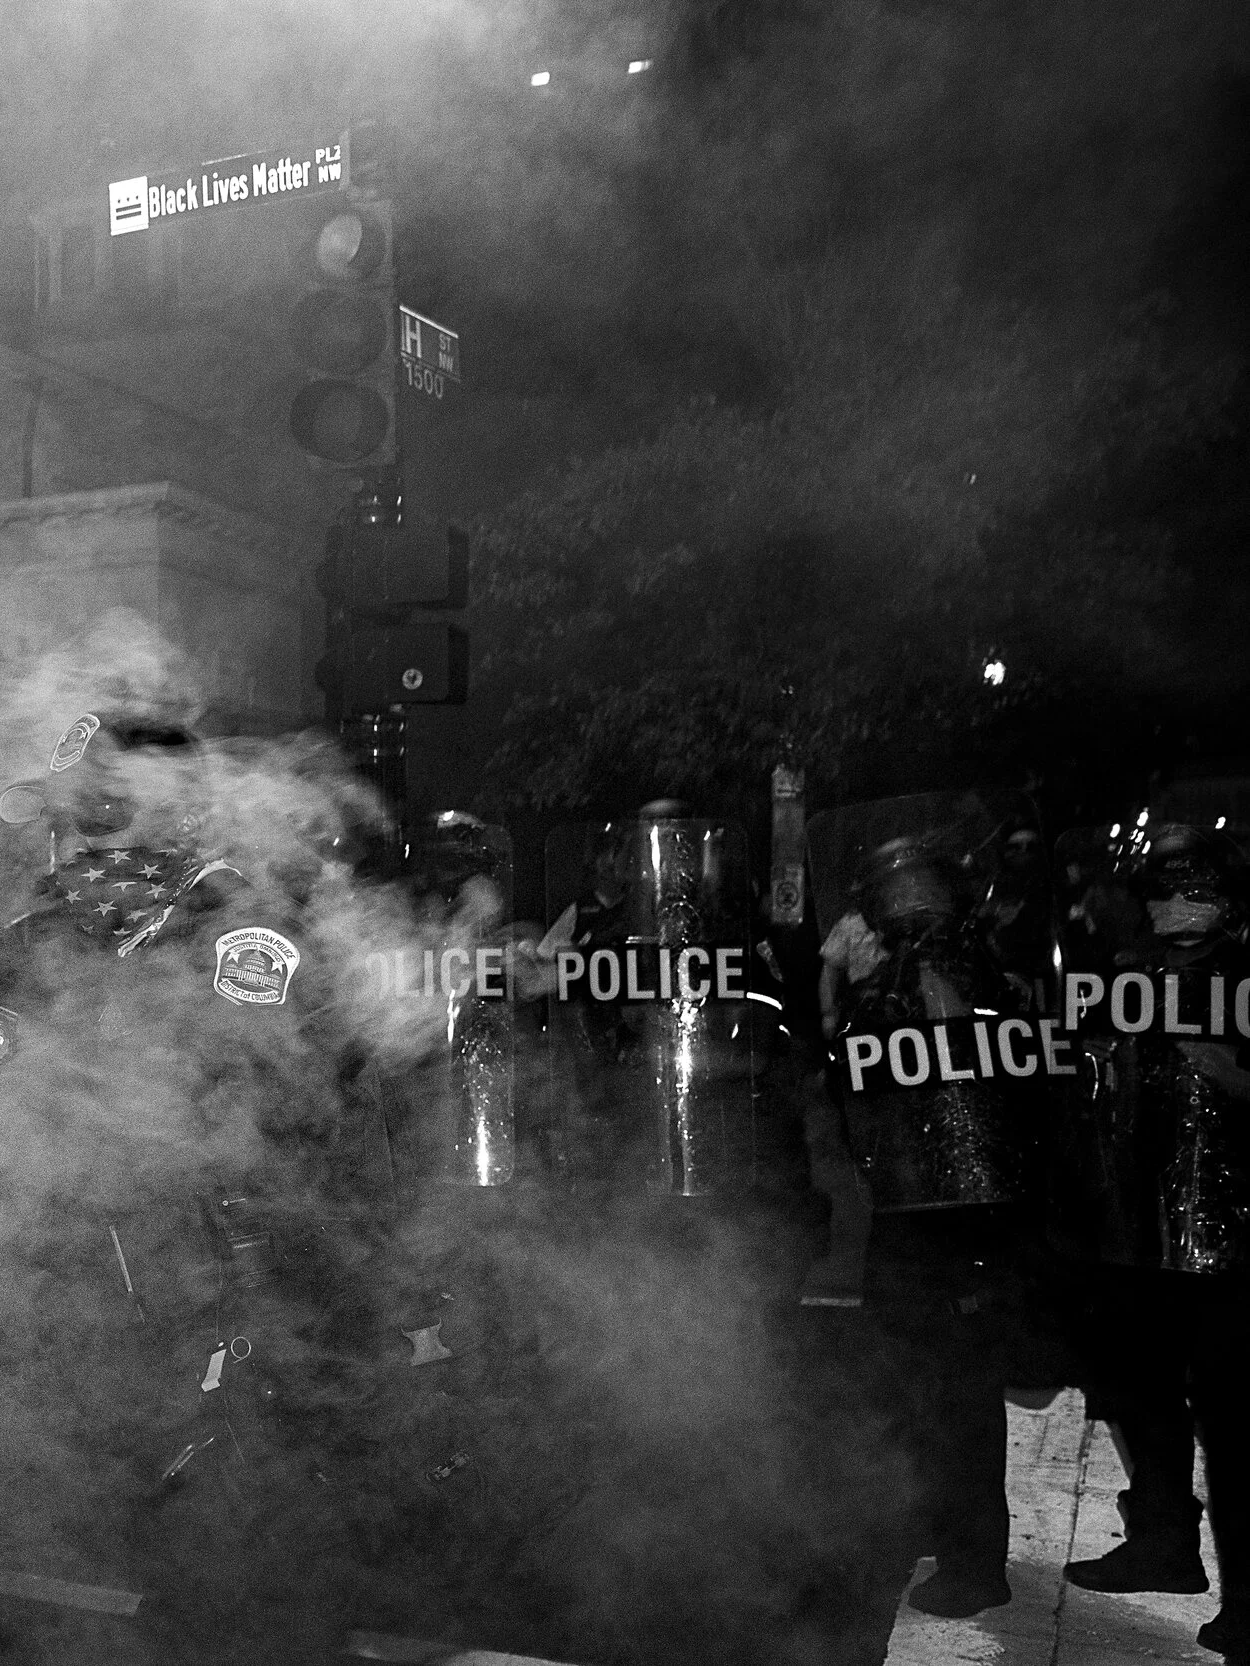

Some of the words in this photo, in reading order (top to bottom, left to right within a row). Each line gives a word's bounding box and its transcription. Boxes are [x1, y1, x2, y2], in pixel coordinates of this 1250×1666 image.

[149, 178, 198, 218] Black
[202, 172, 249, 207] Lives
[252, 157, 311, 197] Matter
[318, 163, 341, 183] NW
[406, 314, 422, 358] H
[405, 360, 444, 399] 1500
[221, 932, 275, 947] METROPOLITAN
[273, 940, 296, 960] POLICE
[365, 947, 504, 1001] OLICE
[557, 948, 745, 1001] POLICE
[845, 1018, 1077, 1092] POLICE
